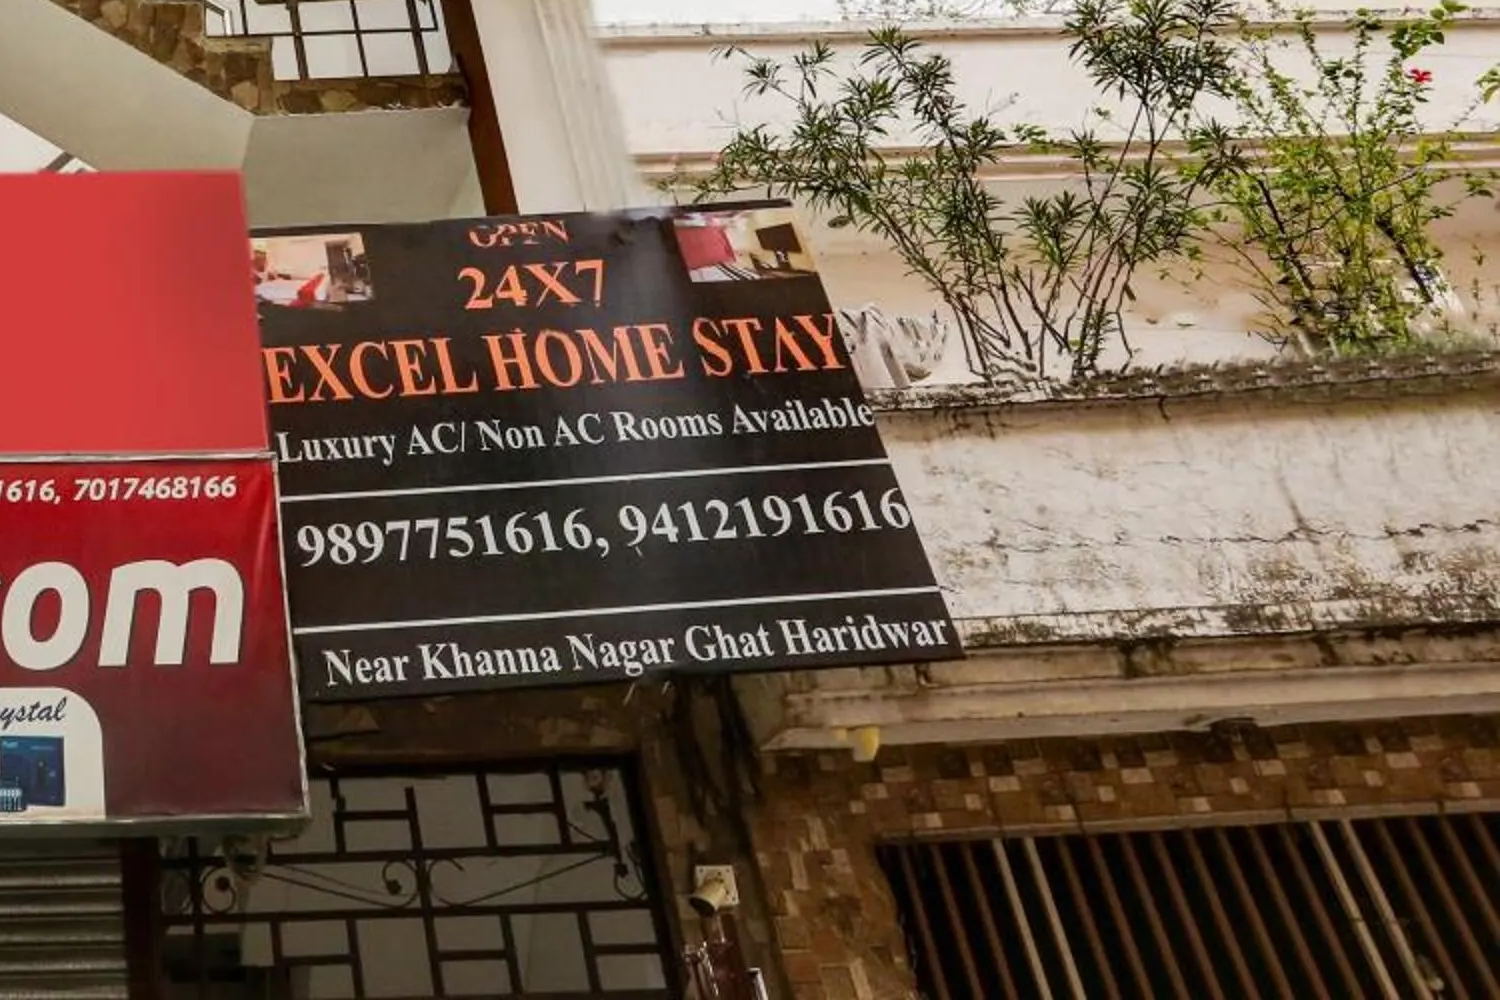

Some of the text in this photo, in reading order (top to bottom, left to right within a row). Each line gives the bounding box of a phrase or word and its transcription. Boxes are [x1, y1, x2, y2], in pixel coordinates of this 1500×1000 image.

[457, 259, 604, 310] 24X7
[263, 314, 846, 403] EXCEL HOME STAY
[276, 431, 396, 466] Luxury
[474, 419, 546, 451] Non
[553, 412, 605, 448] AC
[609, 410, 723, 442] Rooms
[731, 397, 876, 434] Available
[73, 475, 238, 501] 7017468166
[297, 487, 911, 567] 9897751616, 9412191616
[323, 614, 949, 687] Near Khanna Nagar Ghat Haridwar
